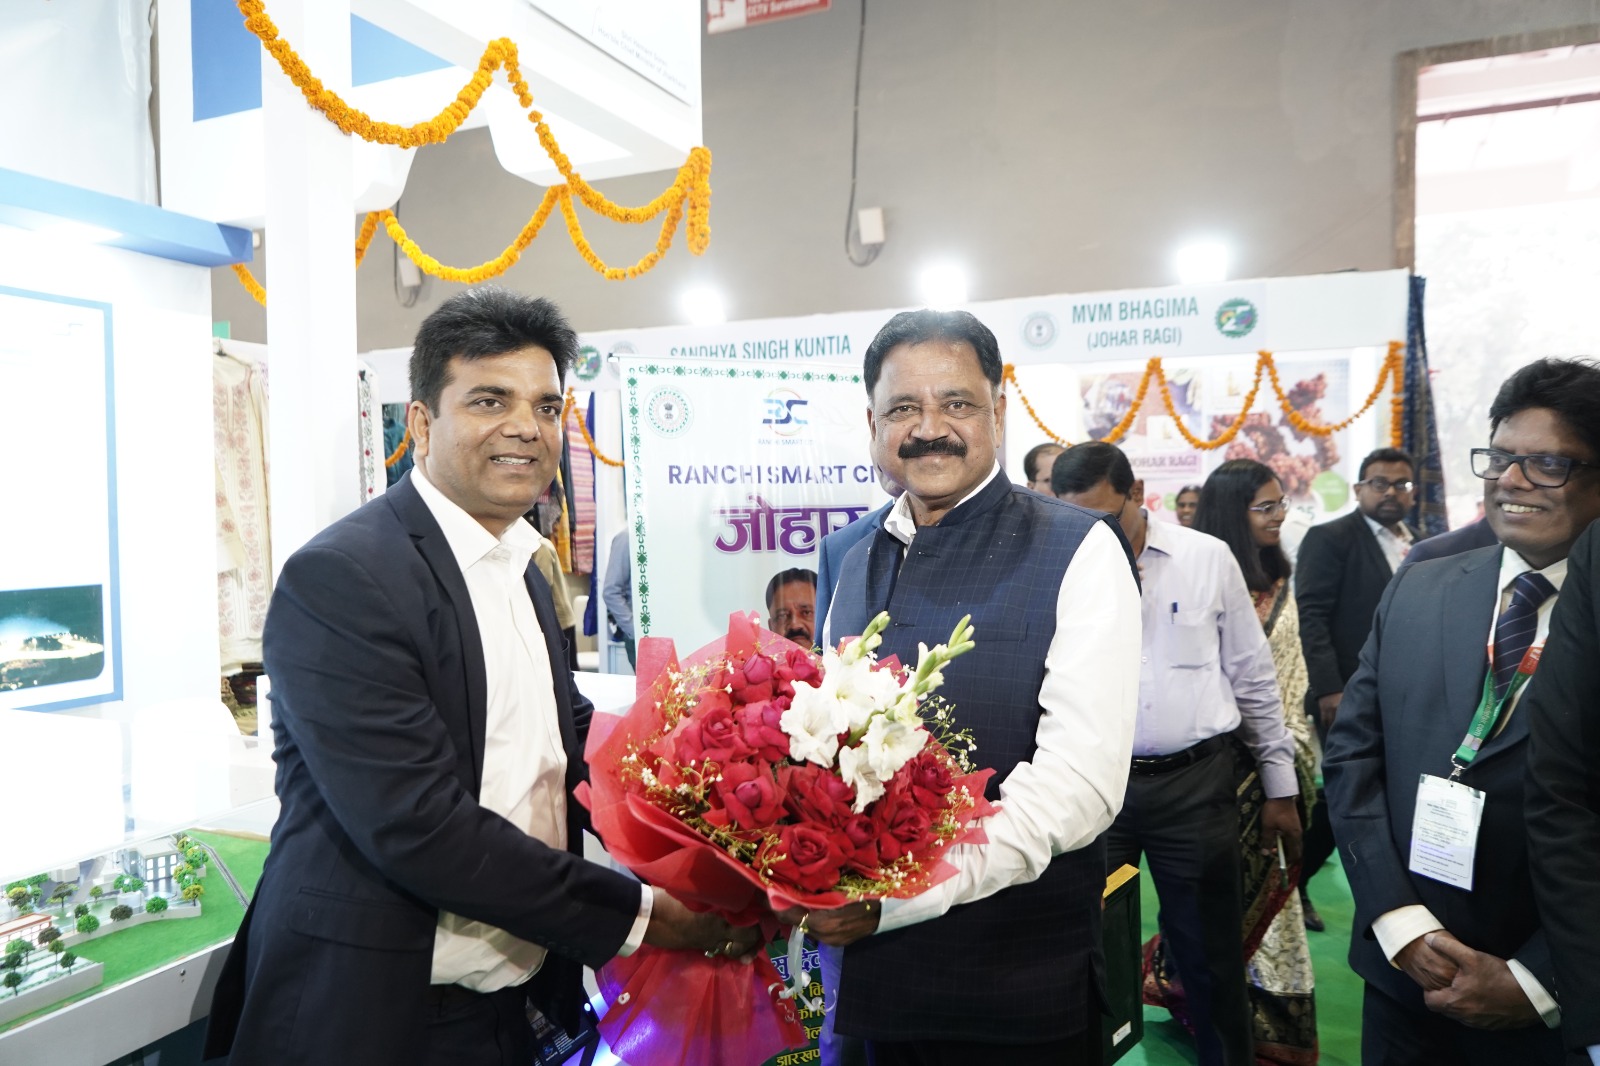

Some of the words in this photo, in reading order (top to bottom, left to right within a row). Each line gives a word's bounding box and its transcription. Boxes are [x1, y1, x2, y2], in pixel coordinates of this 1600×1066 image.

[1072, 302, 1113, 324] MVM
[1119, 297, 1199, 321] BHAGIMA
[742, 339, 789, 360] SINGH
[794, 334, 852, 358] KUNTIA
[1087, 330, 1138, 351] (JOHAR
[1143, 327, 1183, 347] RAGI)
[668, 465, 762, 485] RANCHI
[767, 465, 847, 485] SMART
[853, 464, 876, 484] CI
